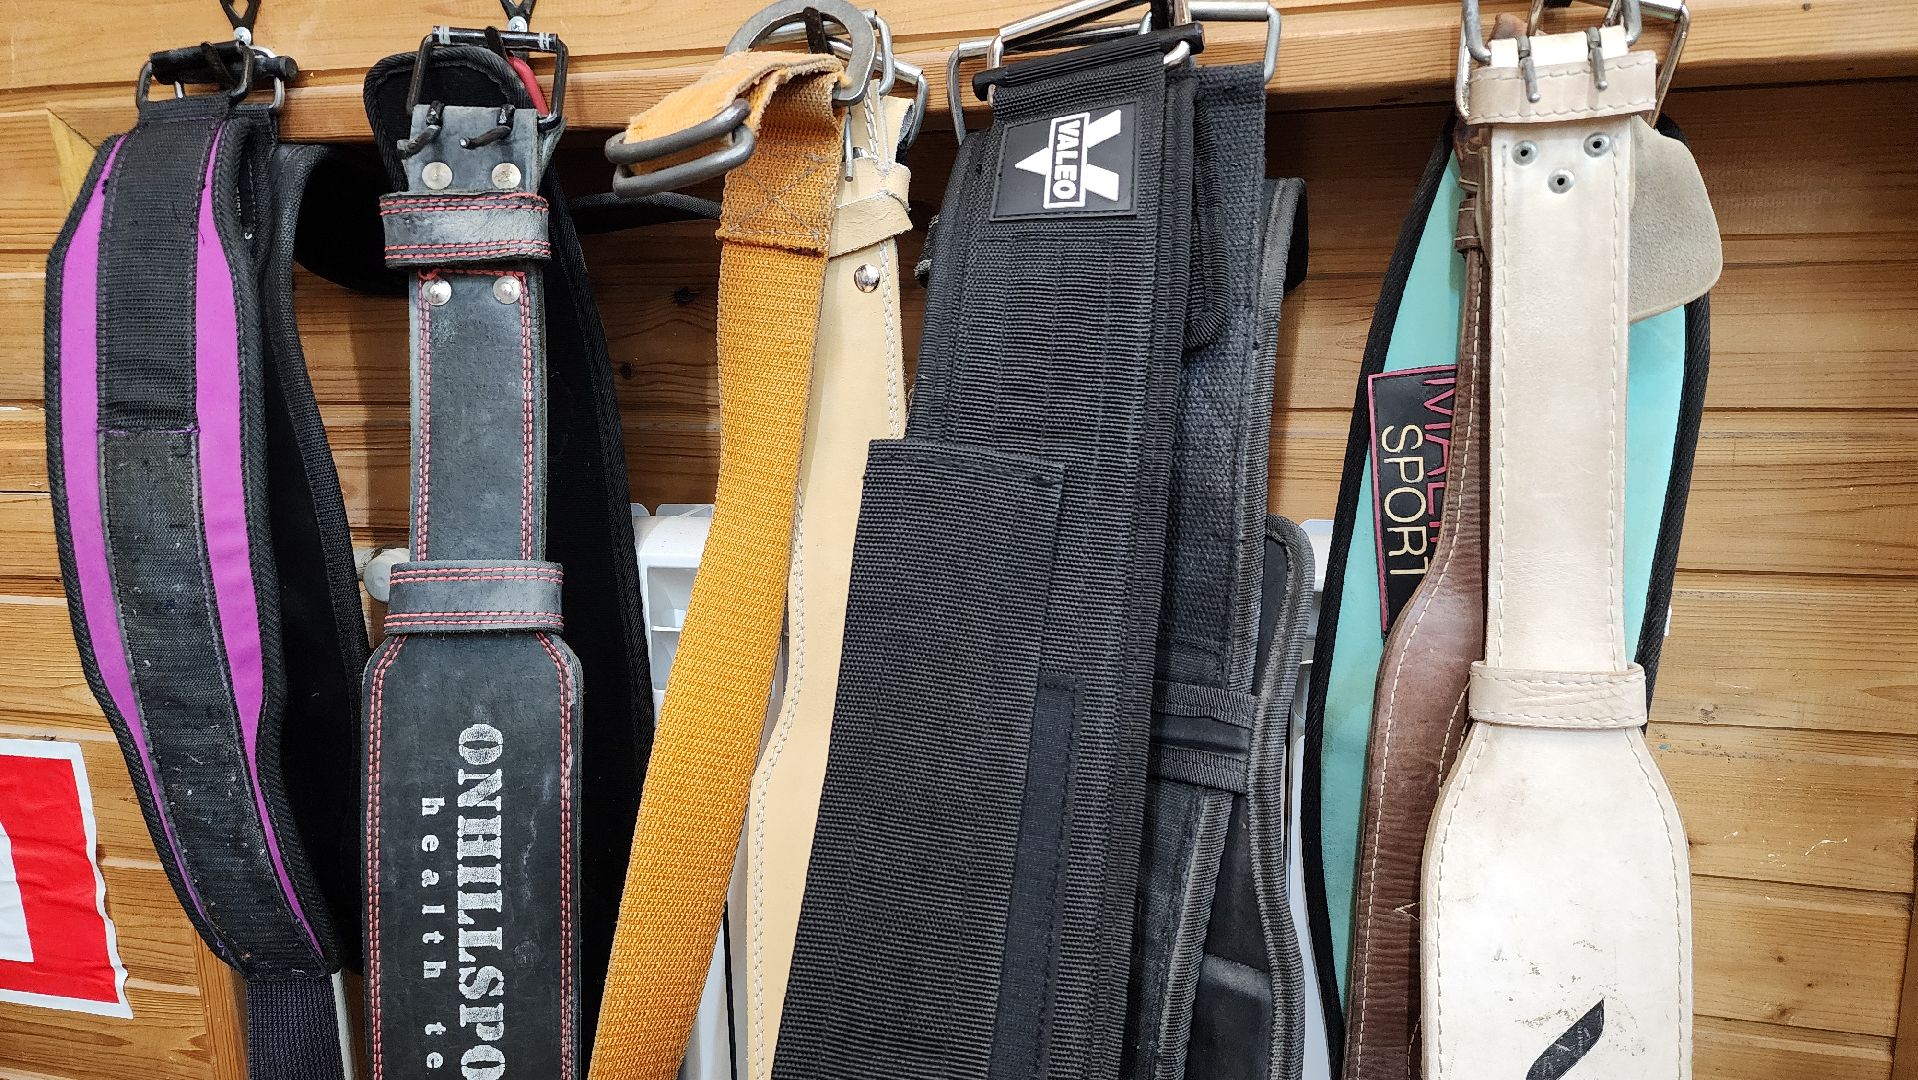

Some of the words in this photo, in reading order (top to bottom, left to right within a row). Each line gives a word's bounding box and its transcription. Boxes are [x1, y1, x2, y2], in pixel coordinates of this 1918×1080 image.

[1053, 119, 1082, 200] VALEO
[1381, 424, 1428, 575] SPORT
[421, 797, 446, 979] health
[424, 1022, 447, 1070] te
